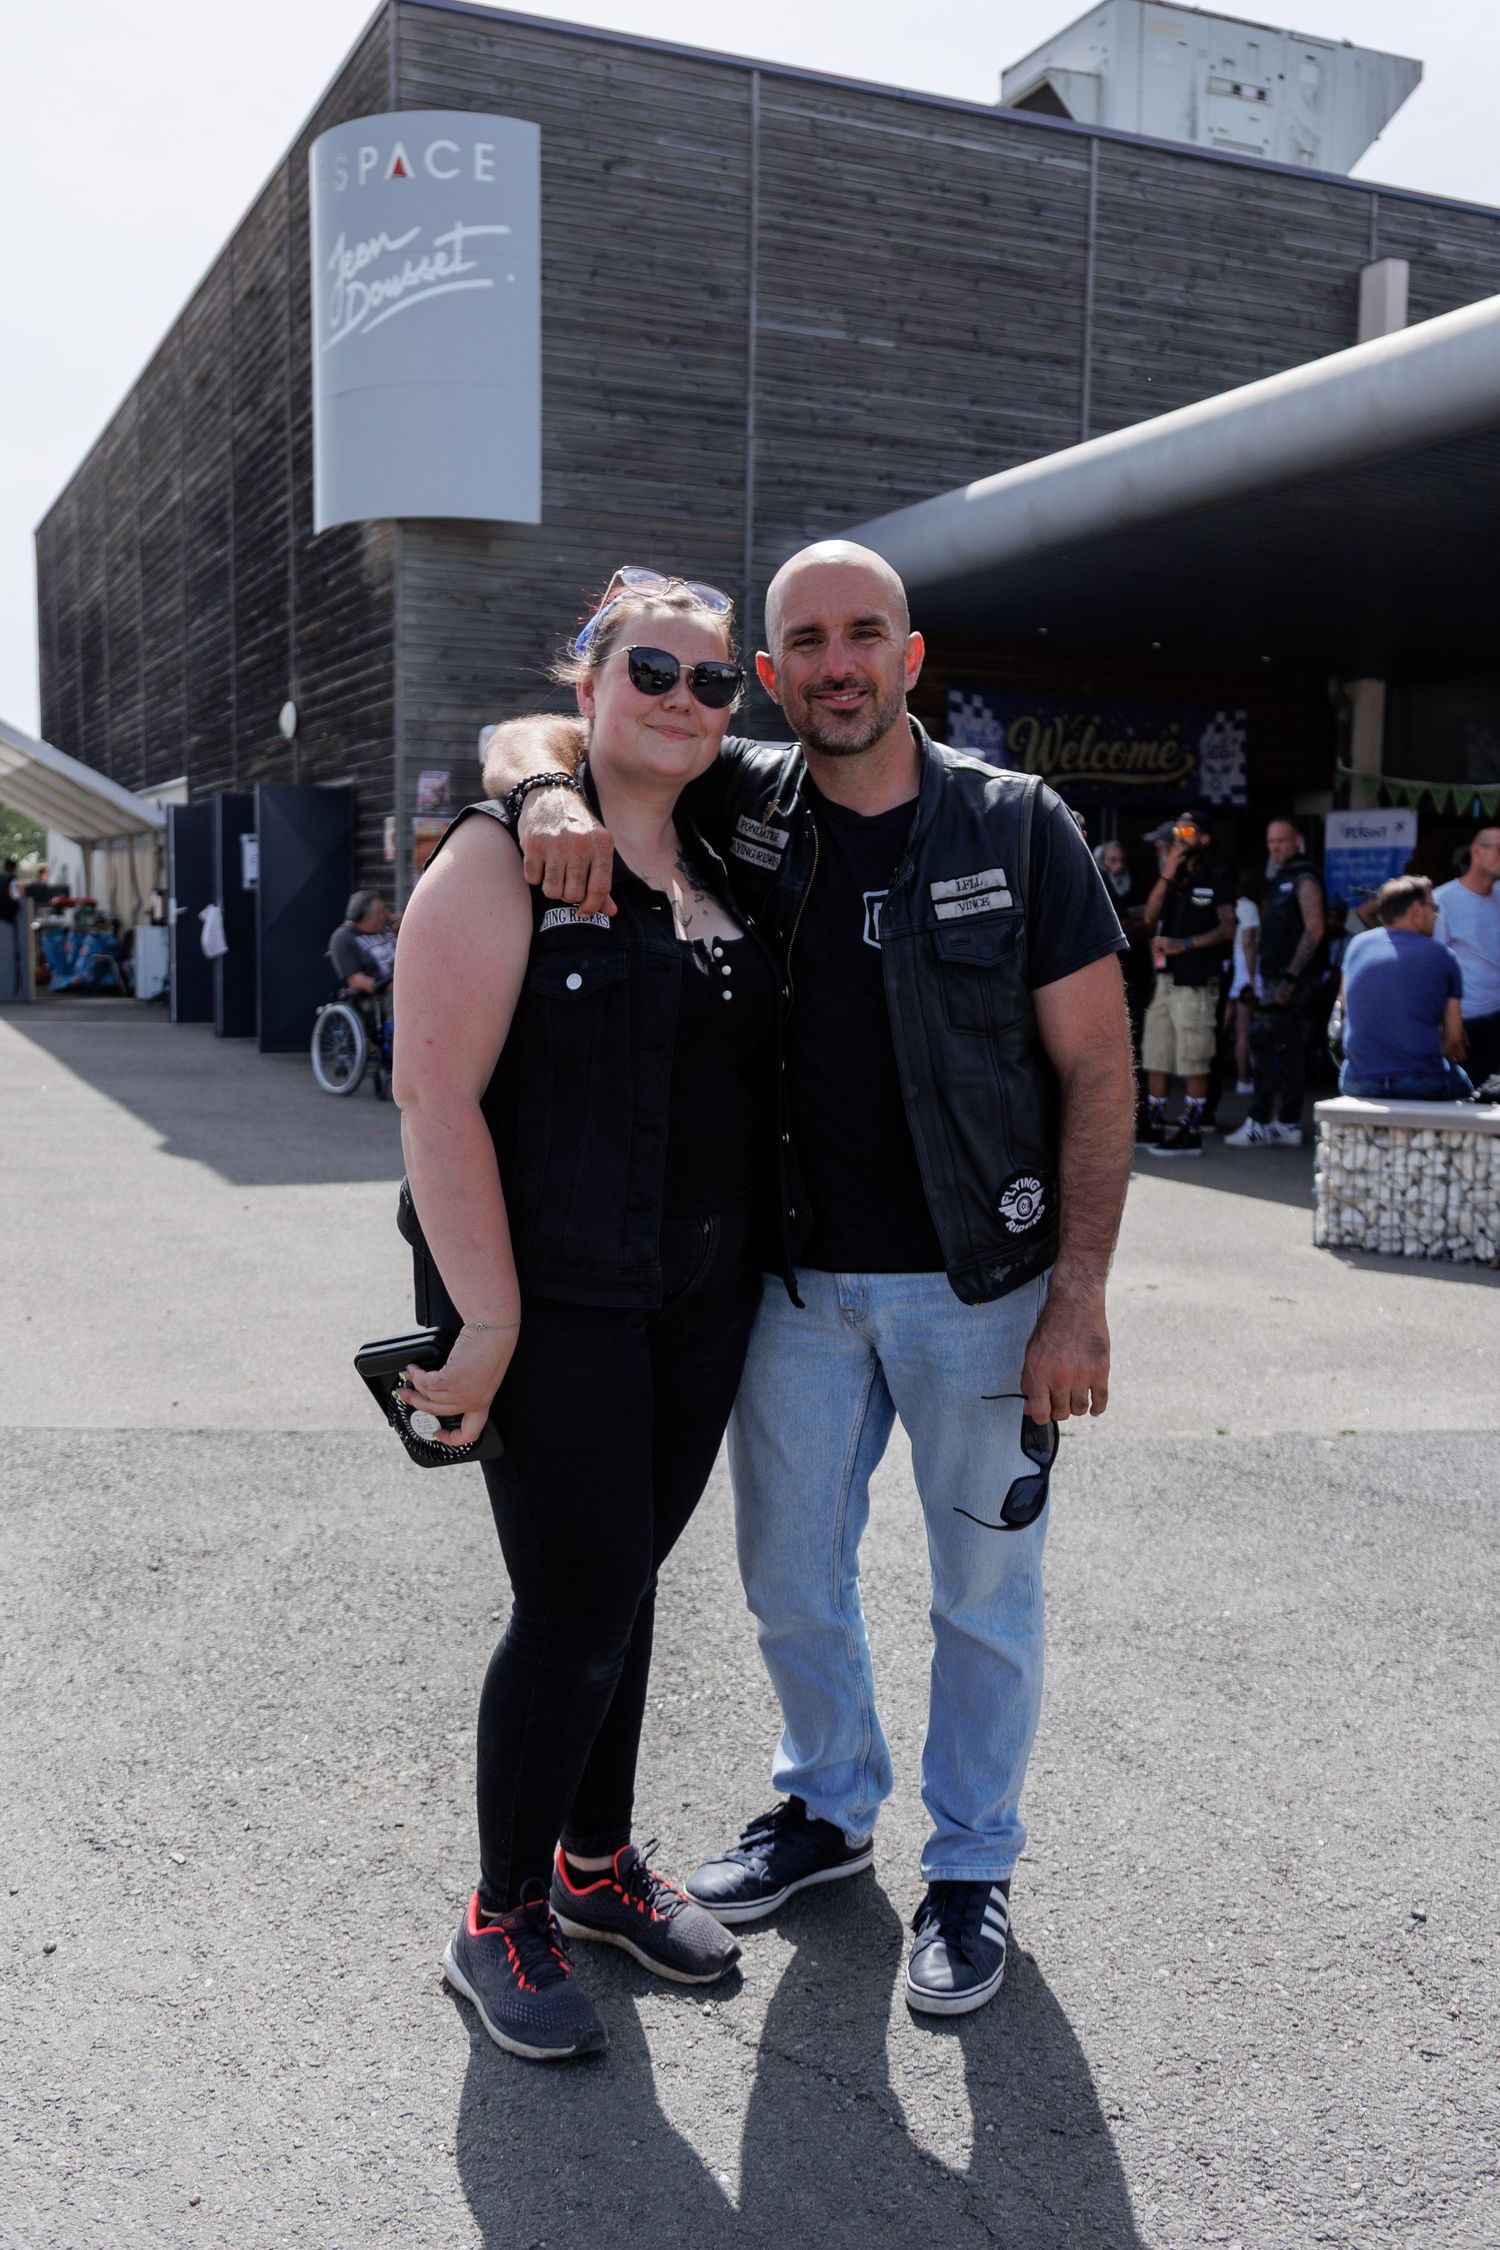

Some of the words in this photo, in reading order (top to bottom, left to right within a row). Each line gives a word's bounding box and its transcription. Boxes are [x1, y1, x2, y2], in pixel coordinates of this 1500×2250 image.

[1007, 715, 1182, 774] Welcome
[958, 897, 990, 912] VINCE
[1001, 1177, 1041, 1206] FLYING
